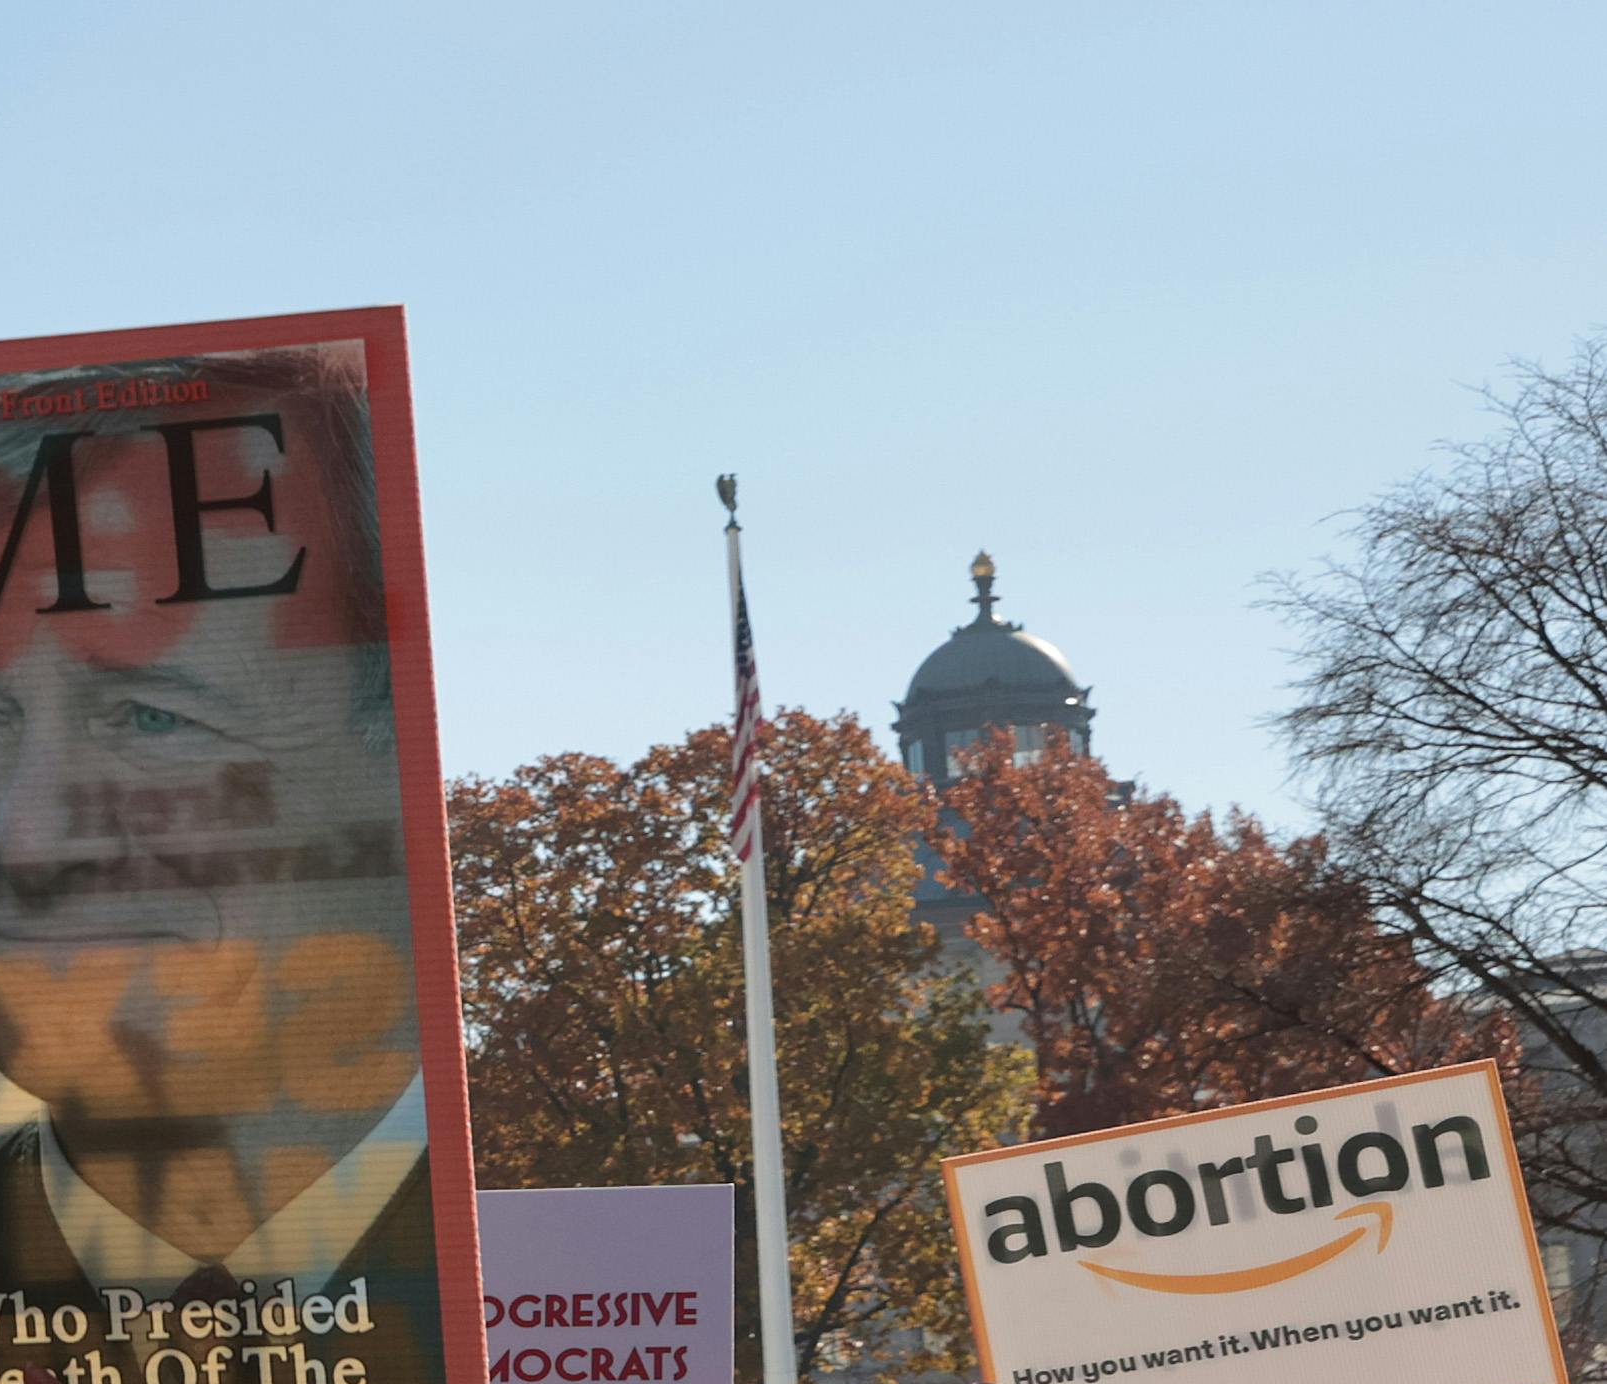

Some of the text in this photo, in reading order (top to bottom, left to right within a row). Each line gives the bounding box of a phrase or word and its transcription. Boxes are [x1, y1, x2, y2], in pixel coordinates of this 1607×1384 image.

[0, 388, 88, 421] Front
[94, 376, 211, 410] Edition
[983, 1113, 1492, 1265] abortion
[99, 1276, 375, 1342] Presided
[1081, 1353, 1137, 1384] you
[1141, 1337, 1215, 1369] want
[1216, 1331, 1250, 1359] it.
[1250, 1320, 1339, 1352] When
[1345, 1310, 1403, 1341] you
[1408, 1294, 1485, 1327] want
[1488, 1289, 1522, 1315] it.
